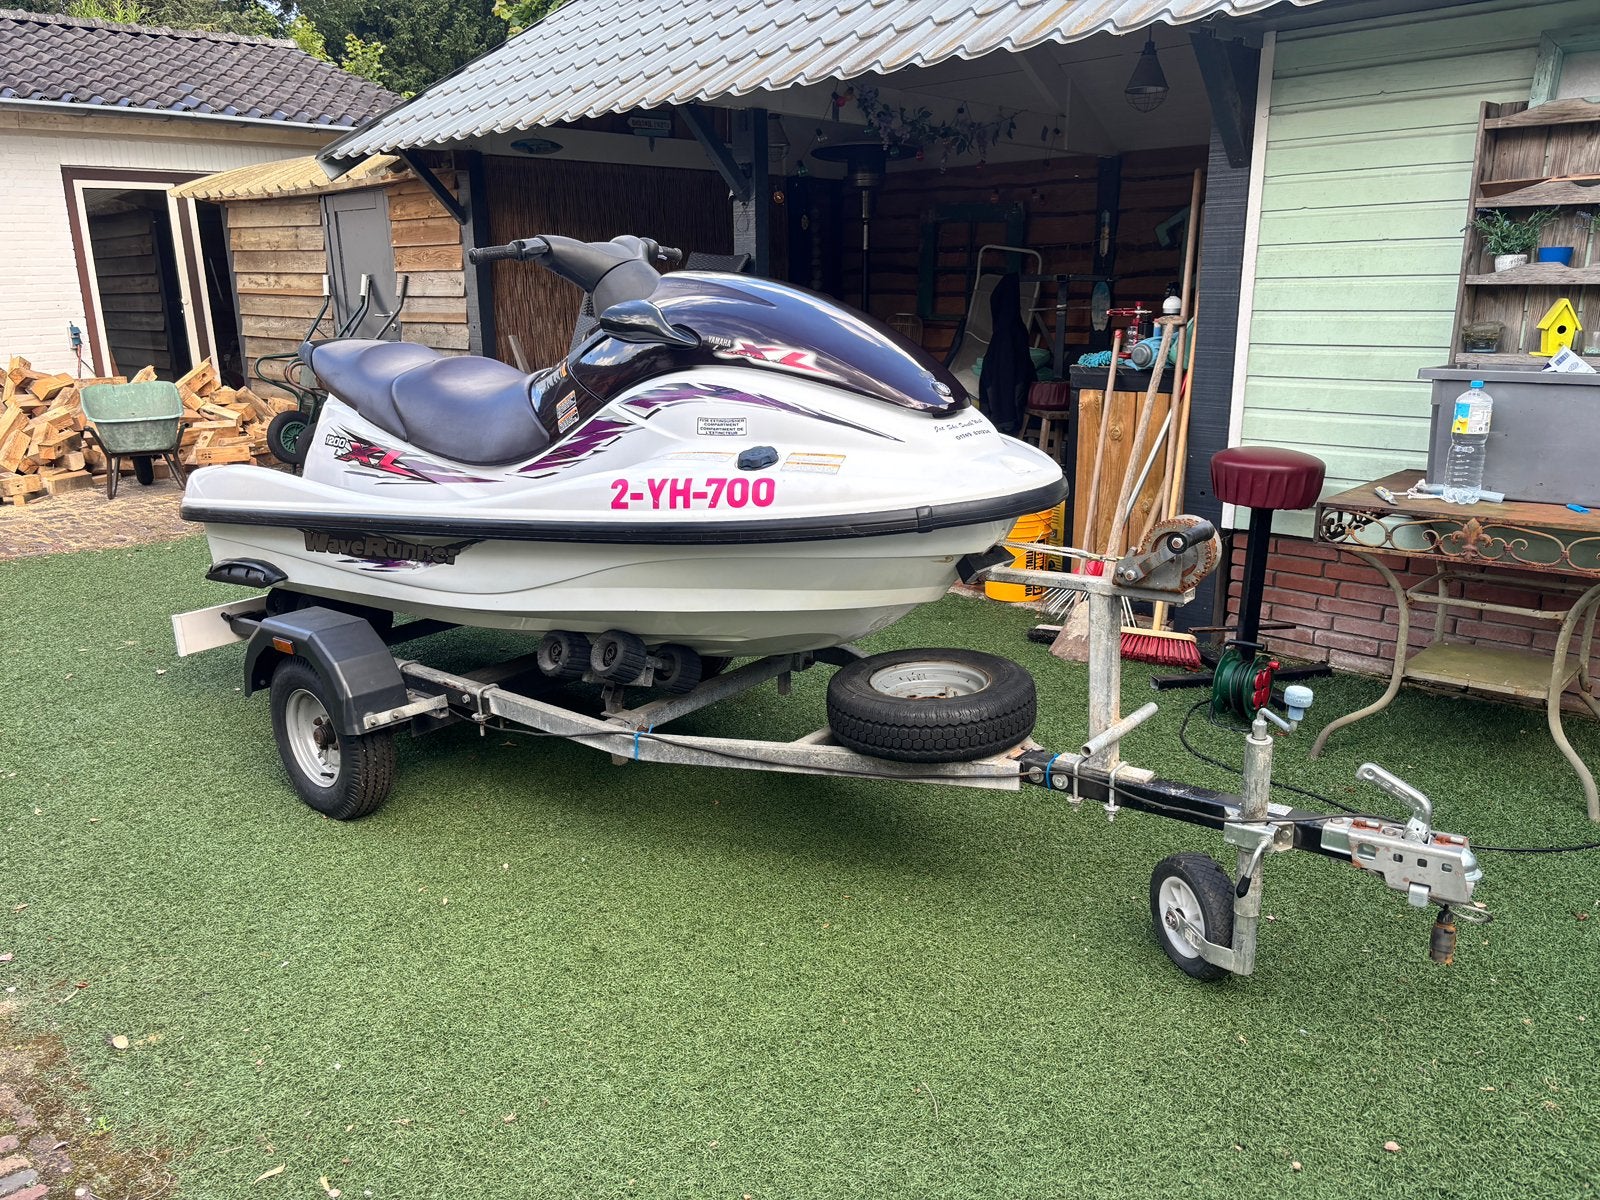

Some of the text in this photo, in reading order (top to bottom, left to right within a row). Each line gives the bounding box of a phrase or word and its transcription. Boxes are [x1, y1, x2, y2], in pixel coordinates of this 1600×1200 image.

[708, 335, 732, 347] YAMAHA
[325, 433, 347, 449] 1200
[336, 439, 426, 480] XL
[610, 477, 776, 510] 2-YH-700
[303, 530, 461, 566] WaveRunner
